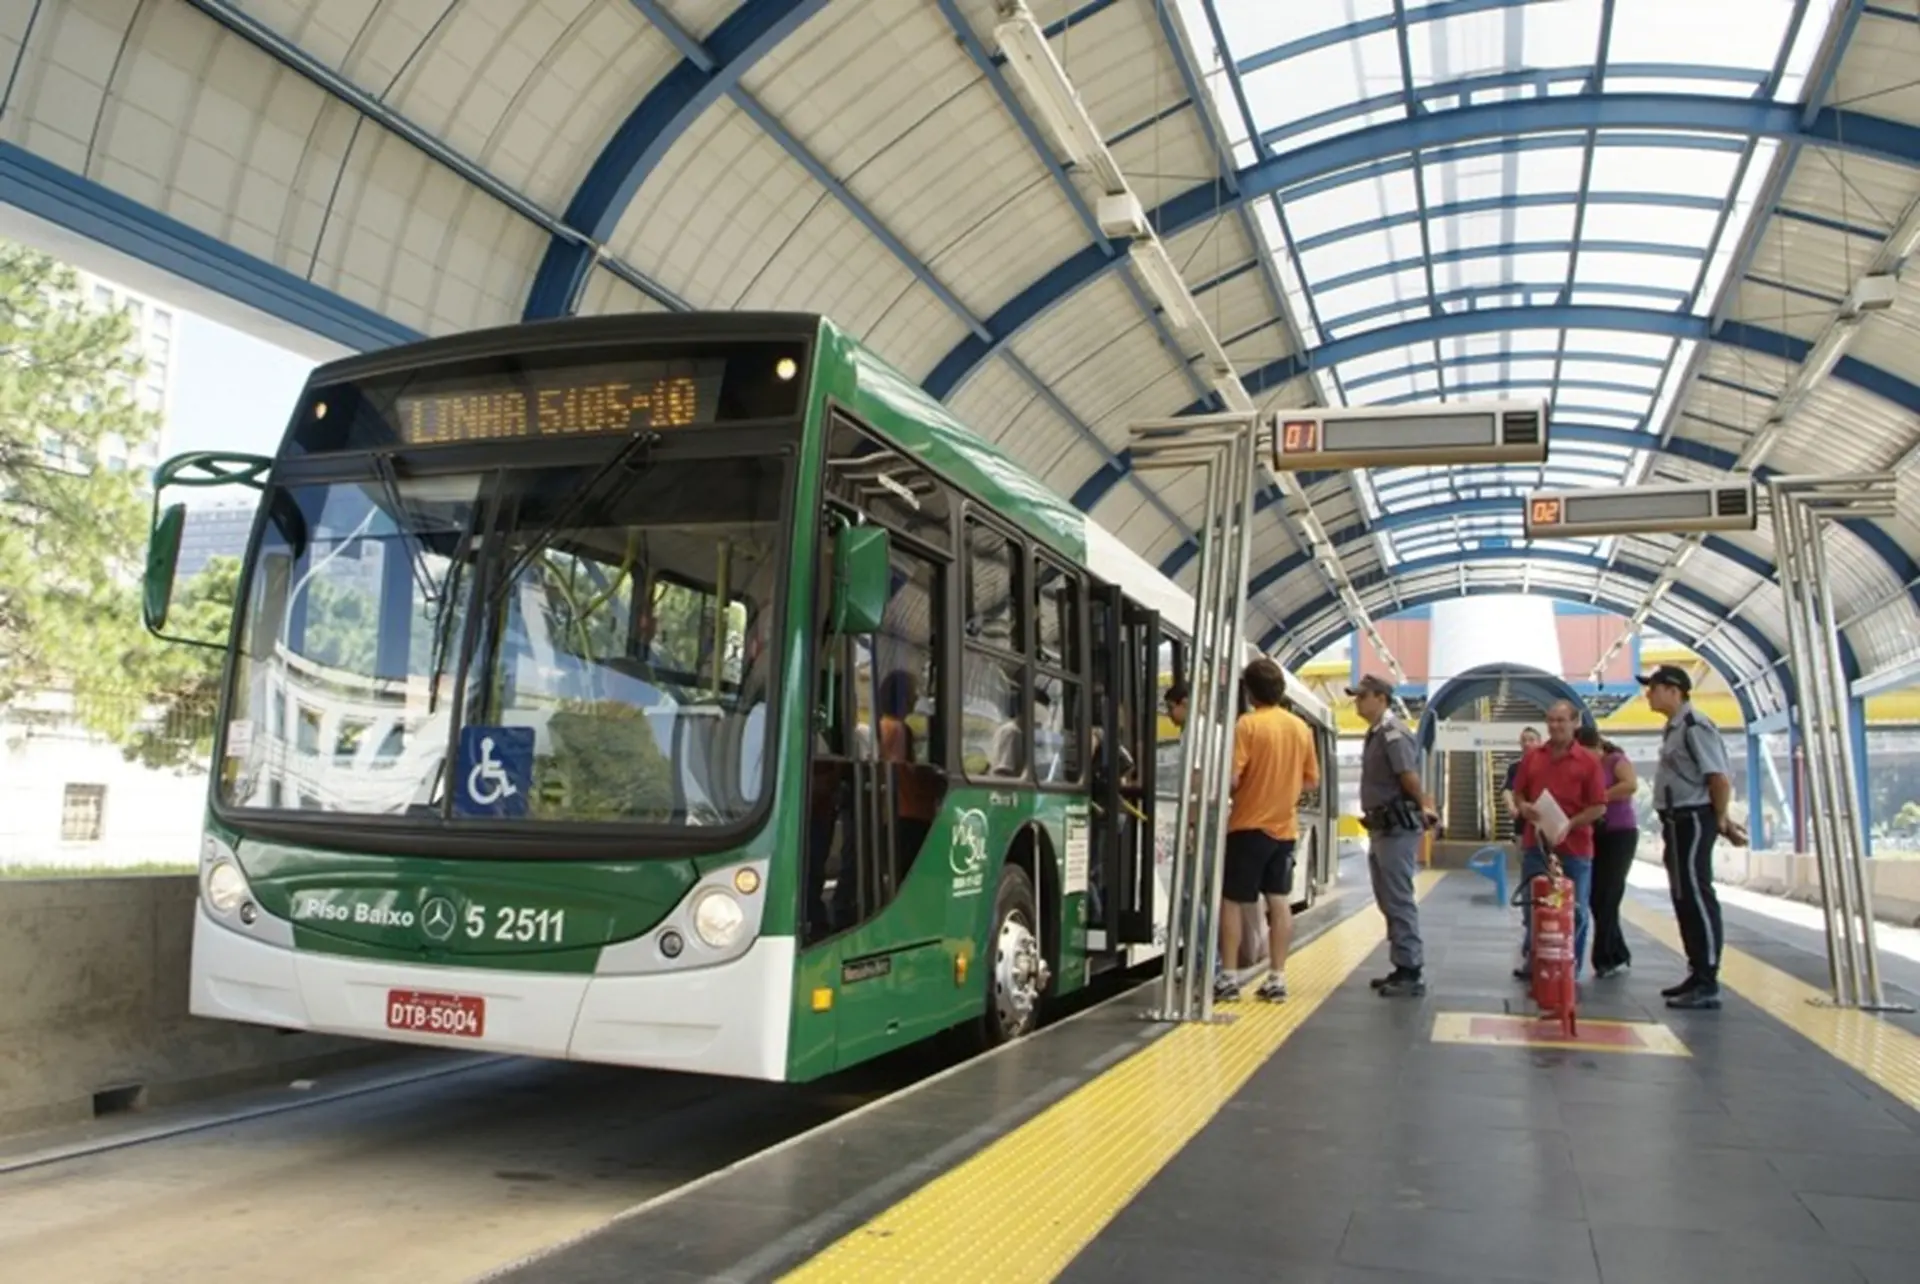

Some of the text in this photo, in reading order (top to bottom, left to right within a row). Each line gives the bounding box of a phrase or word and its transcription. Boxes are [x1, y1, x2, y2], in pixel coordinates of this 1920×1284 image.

[411, 377, 697, 443] LINHA 5105-10
[1285, 424, 1315, 449] 01
[1532, 501, 1558, 522] 02
[305, 899, 415, 928] Piso Baixo
[464, 905, 566, 943] 5 2511
